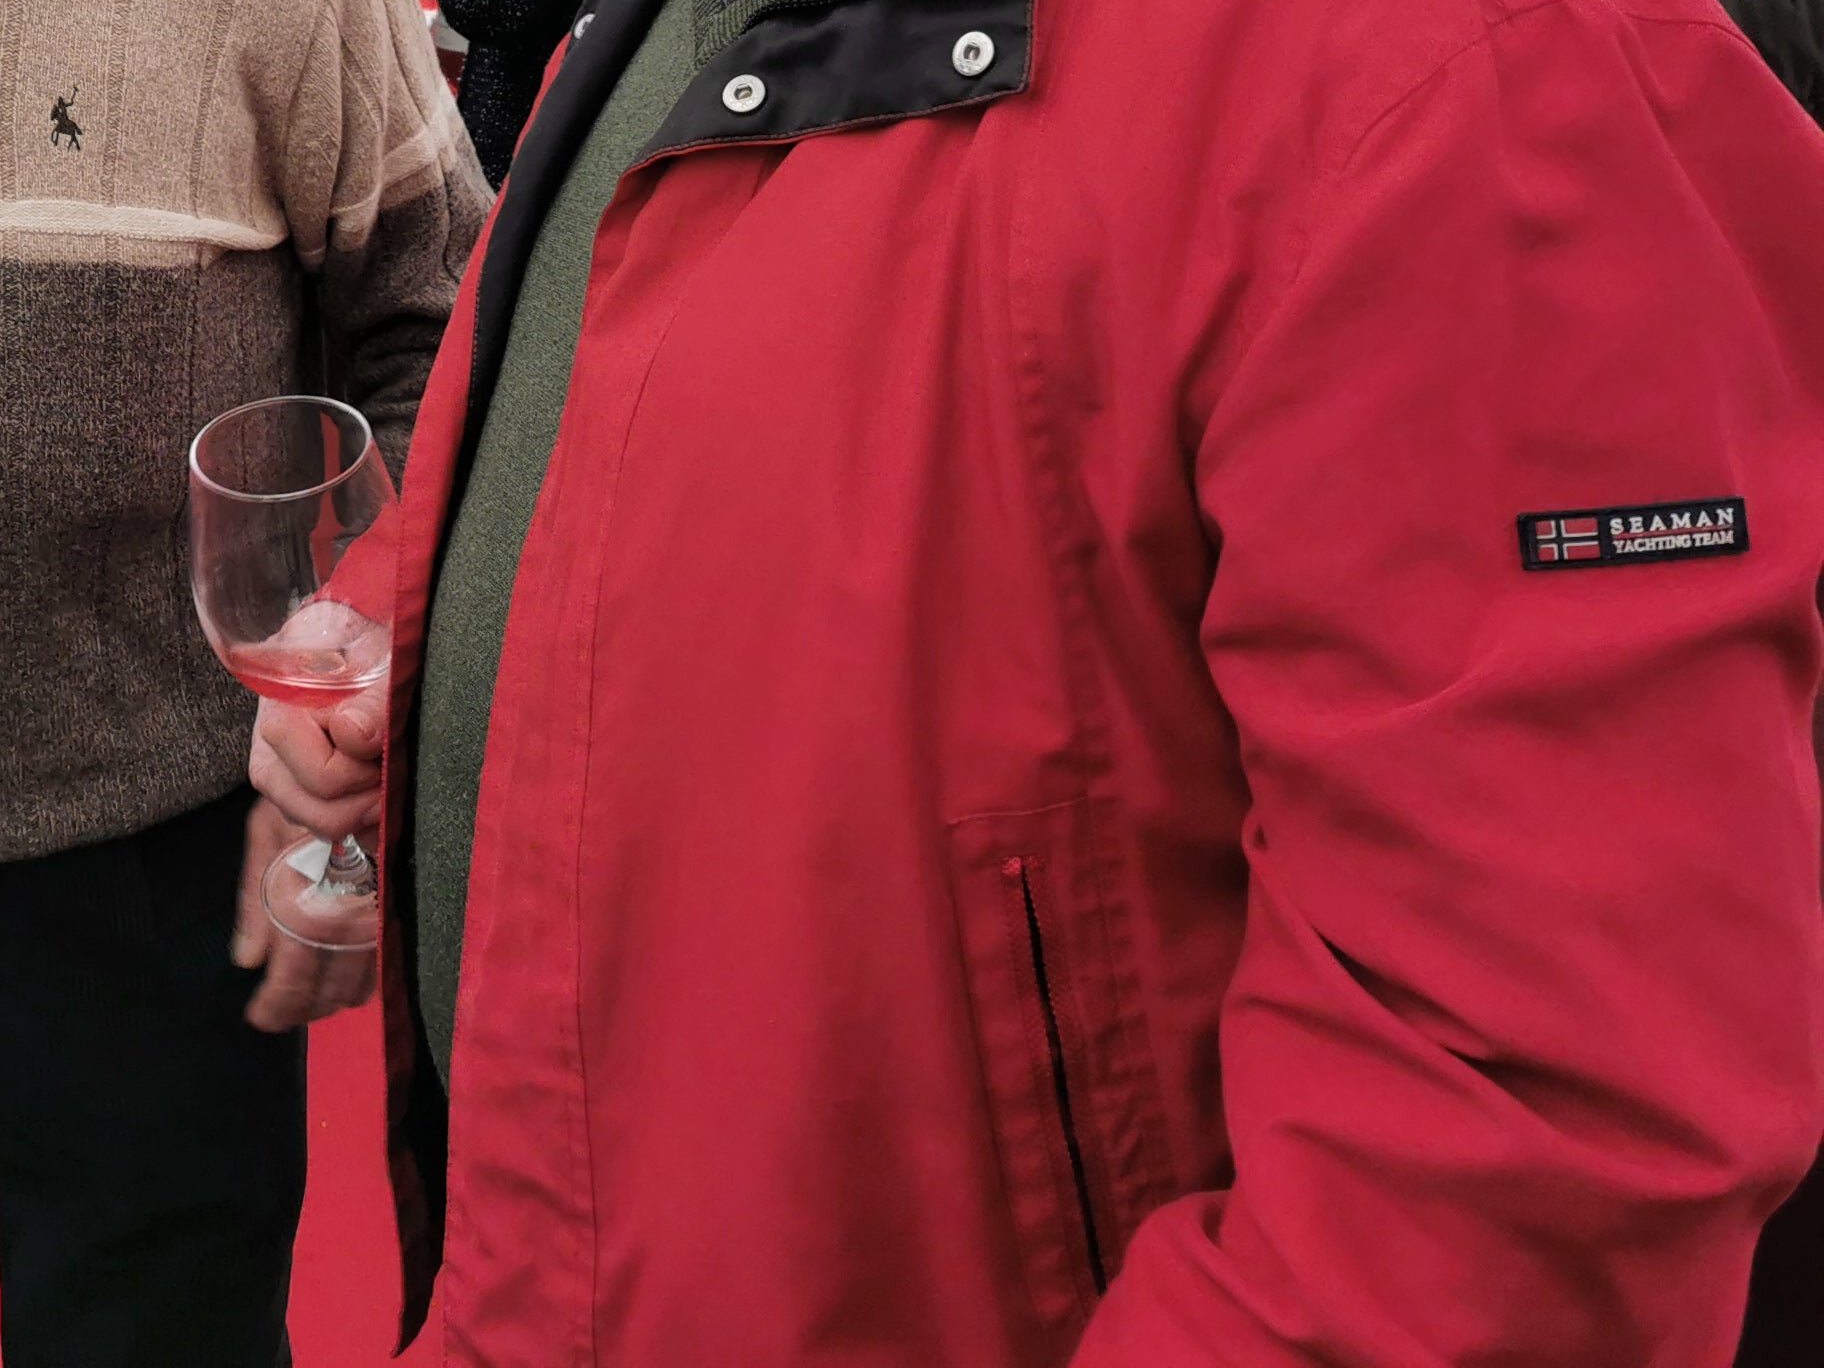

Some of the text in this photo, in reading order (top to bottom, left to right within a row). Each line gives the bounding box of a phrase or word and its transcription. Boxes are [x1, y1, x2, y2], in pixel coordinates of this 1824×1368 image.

[1609, 507, 1735, 535] SEAMAN
[1612, 530, 1735, 554] YACHTING TEAM
